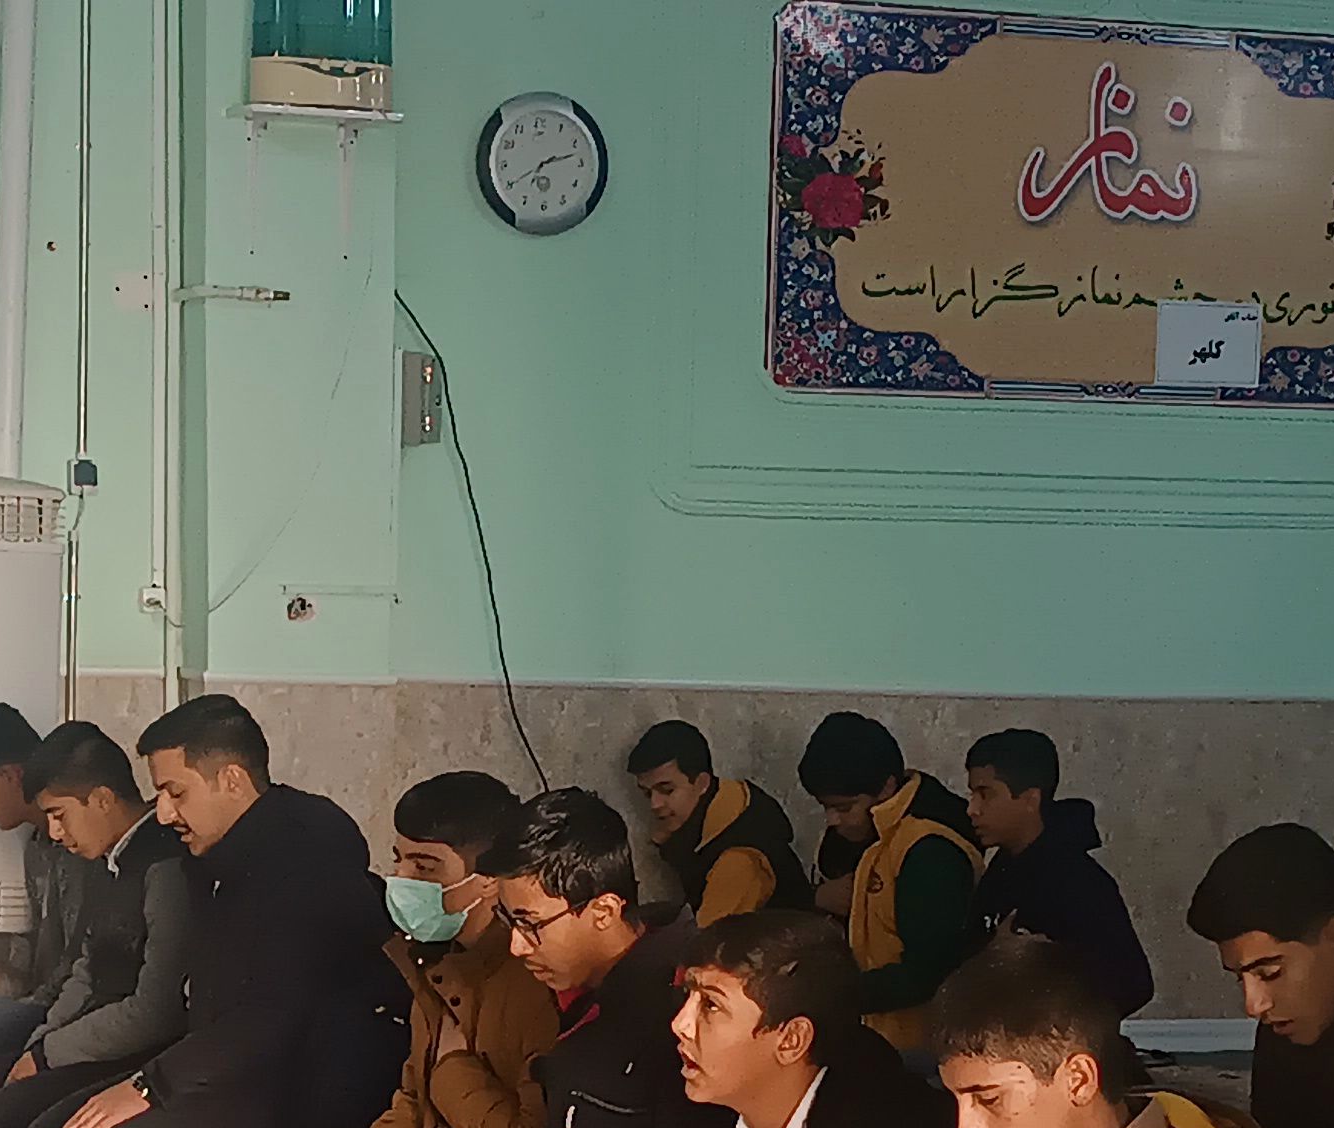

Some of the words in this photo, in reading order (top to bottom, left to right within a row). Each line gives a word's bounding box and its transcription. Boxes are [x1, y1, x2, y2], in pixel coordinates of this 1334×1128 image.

[1018, 61, 1200, 222] نماز
[861, 264, 936, 298] است
[936, 262, 1059, 319] گزار
[1057, 265, 1123, 318] نماز
